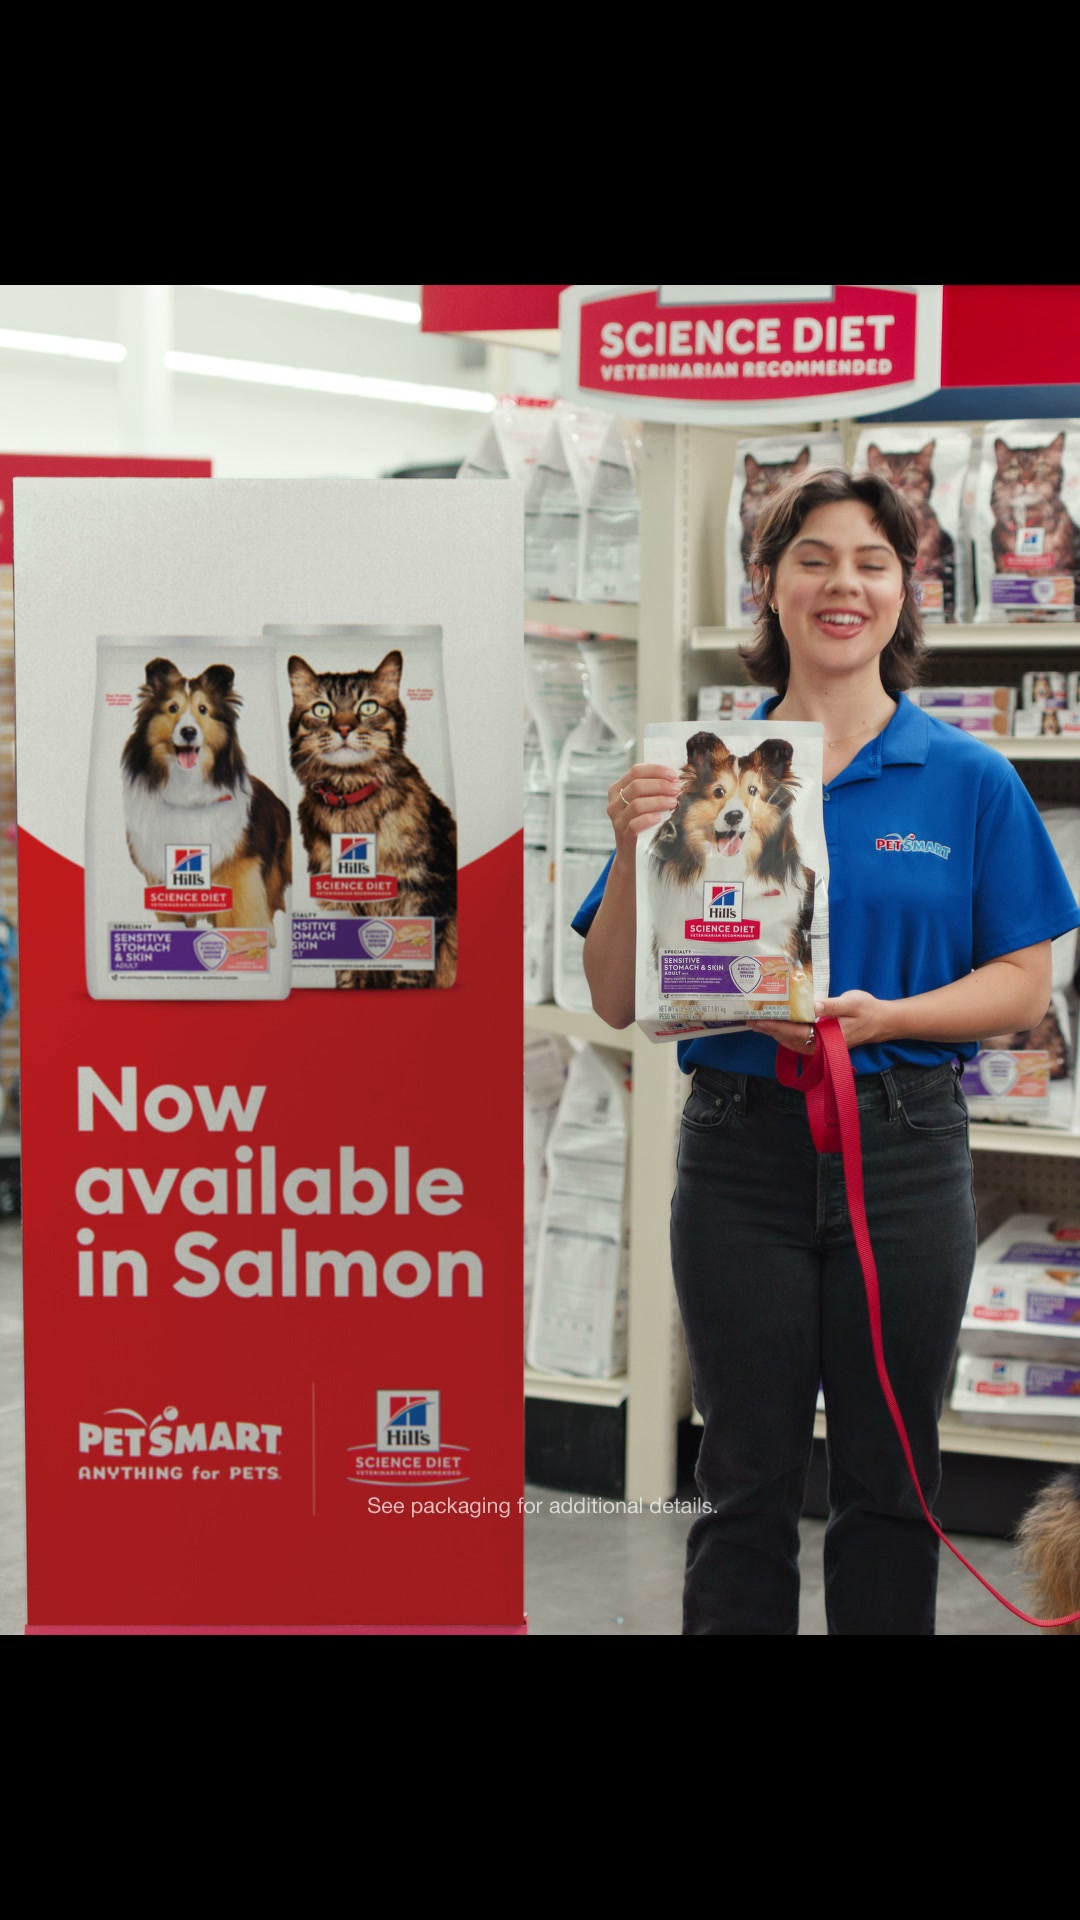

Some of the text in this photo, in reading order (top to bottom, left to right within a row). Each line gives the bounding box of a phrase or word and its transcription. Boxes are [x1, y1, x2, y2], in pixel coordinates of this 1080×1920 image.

[600, 315, 895, 359] SCIENCE DIET
[601, 358, 893, 382] VETERINARIAN RECOMMENDED
[876, 838, 951, 860] PETSMART
[338, 861, 370, 874] Hill's
[173, 873, 205, 886] Hill's
[316, 881, 392, 891] SCIENCE DIET
[150, 893, 228, 902] SCIENCE DIET
[709, 907, 737, 919] Hill's
[293, 921, 337, 931] NSITIVE
[690, 924, 755, 934] SCIENCE DIET
[114, 933, 172, 943] SENSITIVE
[292, 931, 336, 941] OMACH
[114, 943, 171, 952] STOMACH
[292, 941, 318, 950] SKIN
[114, 953, 153, 962] & SKIN
[77, 1066, 267, 1133] Now
[75, 1145, 464, 1216] available
[77, 1227, 484, 1298] in Salmon
[79, 1421, 282, 1457] PETSMART
[387, 1429, 431, 1446] Hill's
[356, 1456, 462, 1469] SCIENCE DIET
[78, 1466, 183, 1480] ANYTHING
[192, 1466, 220, 1480] for
